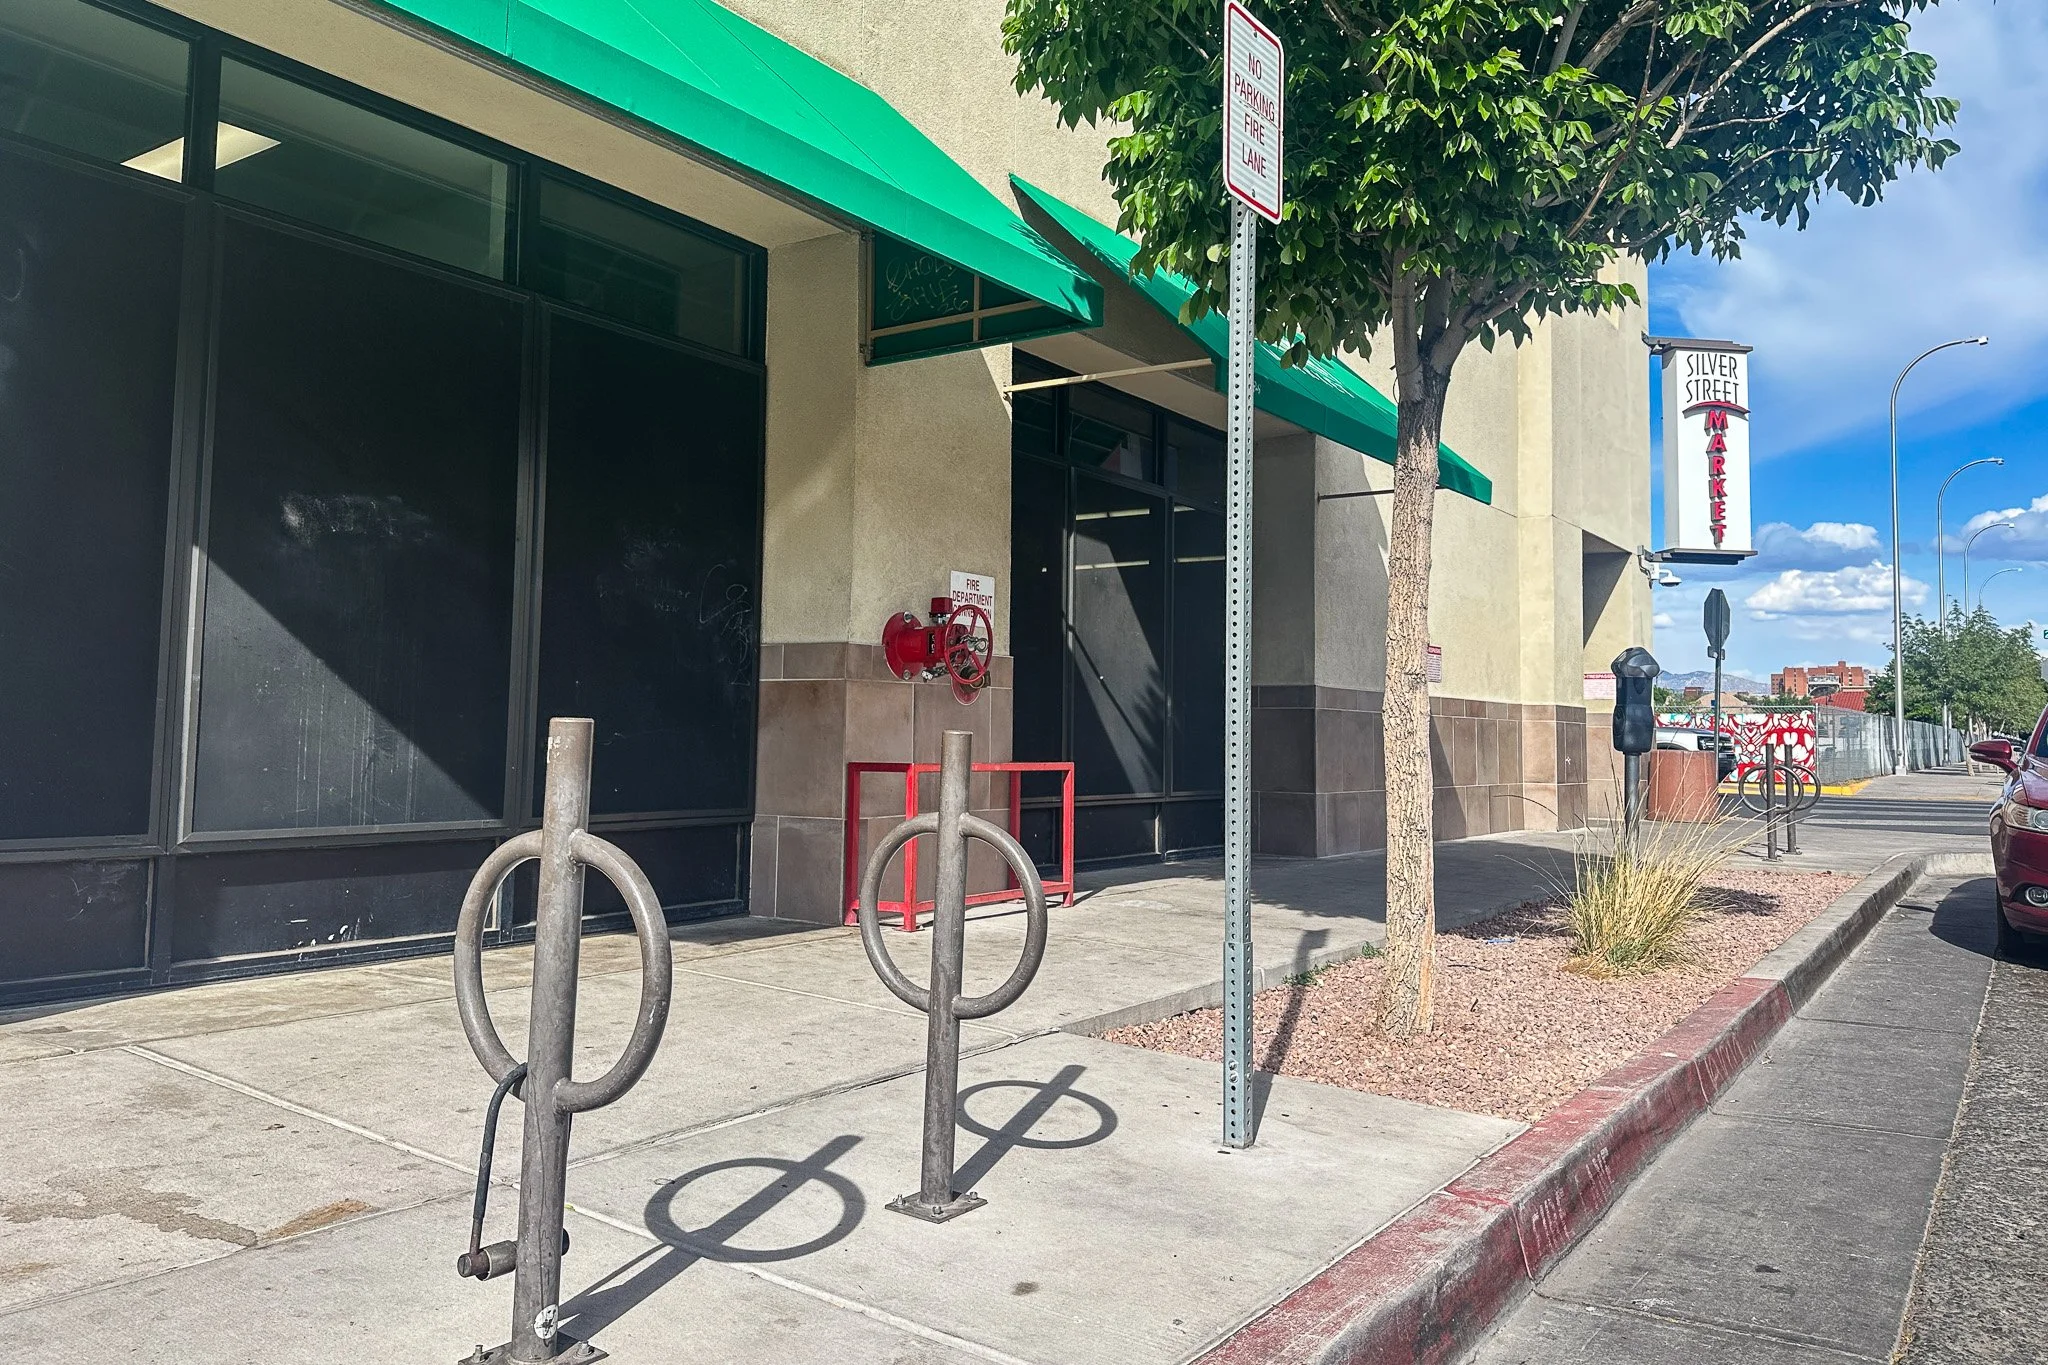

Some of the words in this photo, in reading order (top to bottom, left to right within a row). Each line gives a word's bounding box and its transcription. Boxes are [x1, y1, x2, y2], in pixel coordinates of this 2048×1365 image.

[1248, 52, 1262, 81] NO
[1234, 72, 1275, 122] PARKING
[1244, 112, 1265, 147] FIRE
[1242, 142, 1267, 179] LANE
[1686, 353, 1738, 380] SILVER
[1685, 379, 1740, 405] STREET
[1705, 409, 1729, 547] MARKET
[952, 590, 993, 607] DEPARTMENT
[966, 578, 980, 592] FIRE
